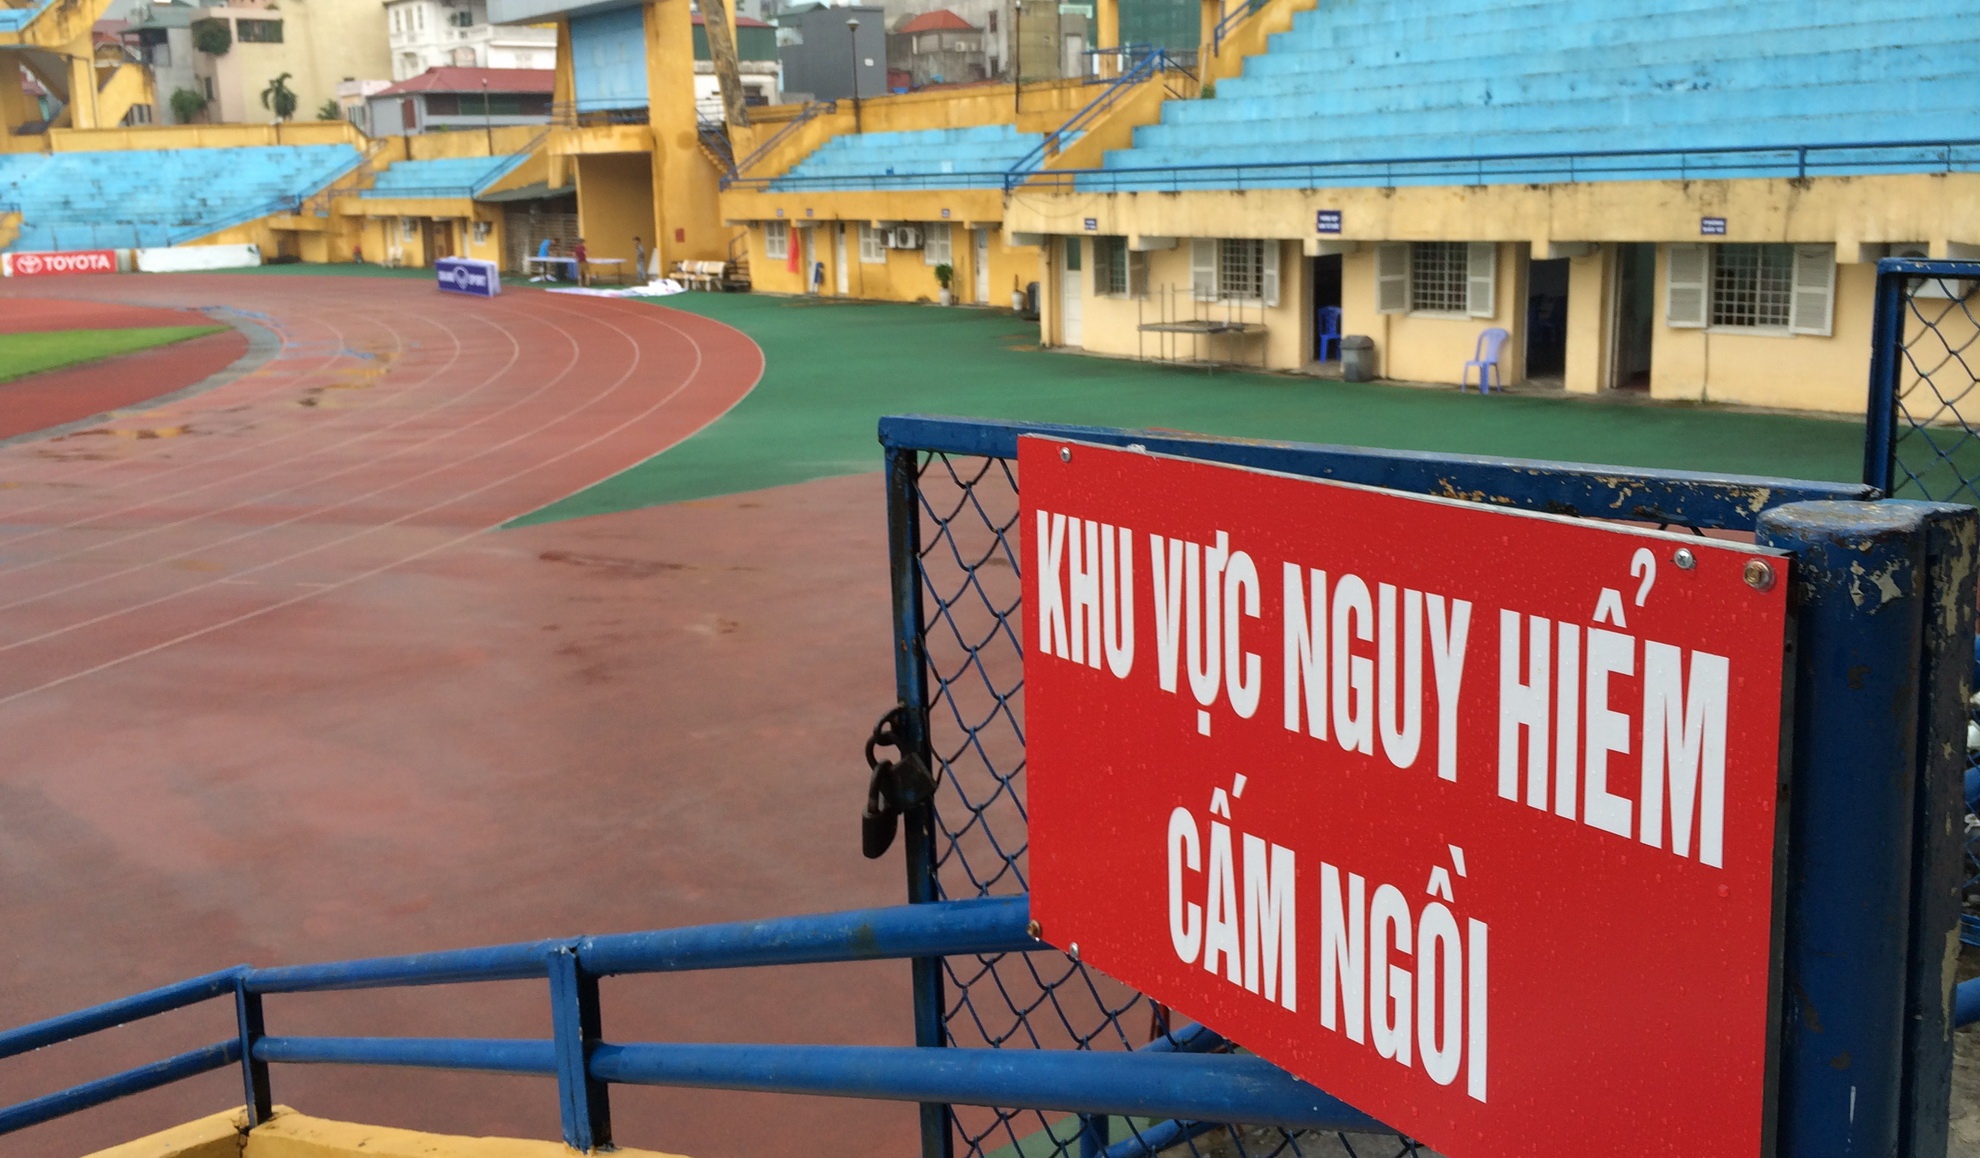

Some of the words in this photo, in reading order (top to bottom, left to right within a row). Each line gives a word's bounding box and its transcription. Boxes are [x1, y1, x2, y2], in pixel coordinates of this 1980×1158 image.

[42, 254, 111, 271] TOYOTA
[1036, 509, 1135, 679] KHU
[1150, 530, 1261, 737] VỰC
[1283, 561, 1473, 783] NGUY
[1498, 548, 1730, 869] HIỂM
[1168, 772, 1297, 1013] CẤM
[1320, 844, 1488, 1104] NGỒI
